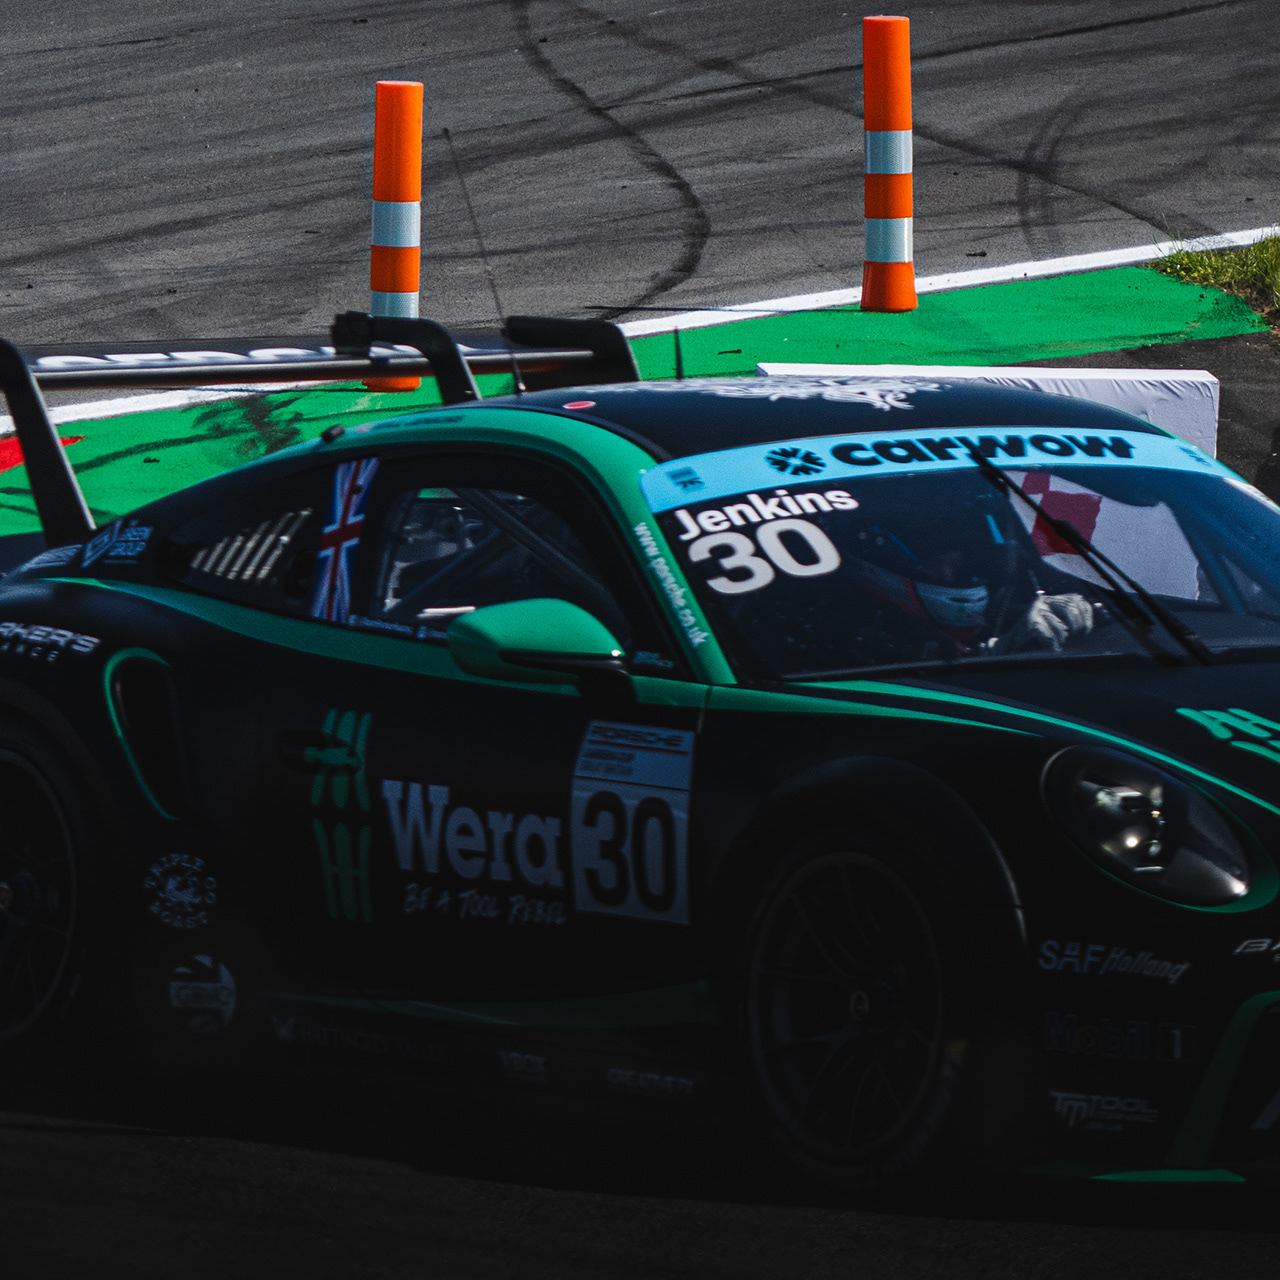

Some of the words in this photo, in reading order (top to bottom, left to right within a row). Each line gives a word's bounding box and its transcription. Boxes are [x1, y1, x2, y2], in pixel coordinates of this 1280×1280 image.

[830, 432, 1137, 467] carwow
[675, 486, 860, 543] Jenkins
[688, 519, 843, 596] 30
[591, 724, 683, 748] PORSCHE
[381, 778, 565, 889] Wera
[583, 790, 677, 912] 30
[404, 882, 433, 915] BE
[436, 890, 455, 913] A
[458, 888, 502, 919] TOOL
[507, 893, 568, 926] REBEL
[1044, 1011, 1150, 1061] Mobil
